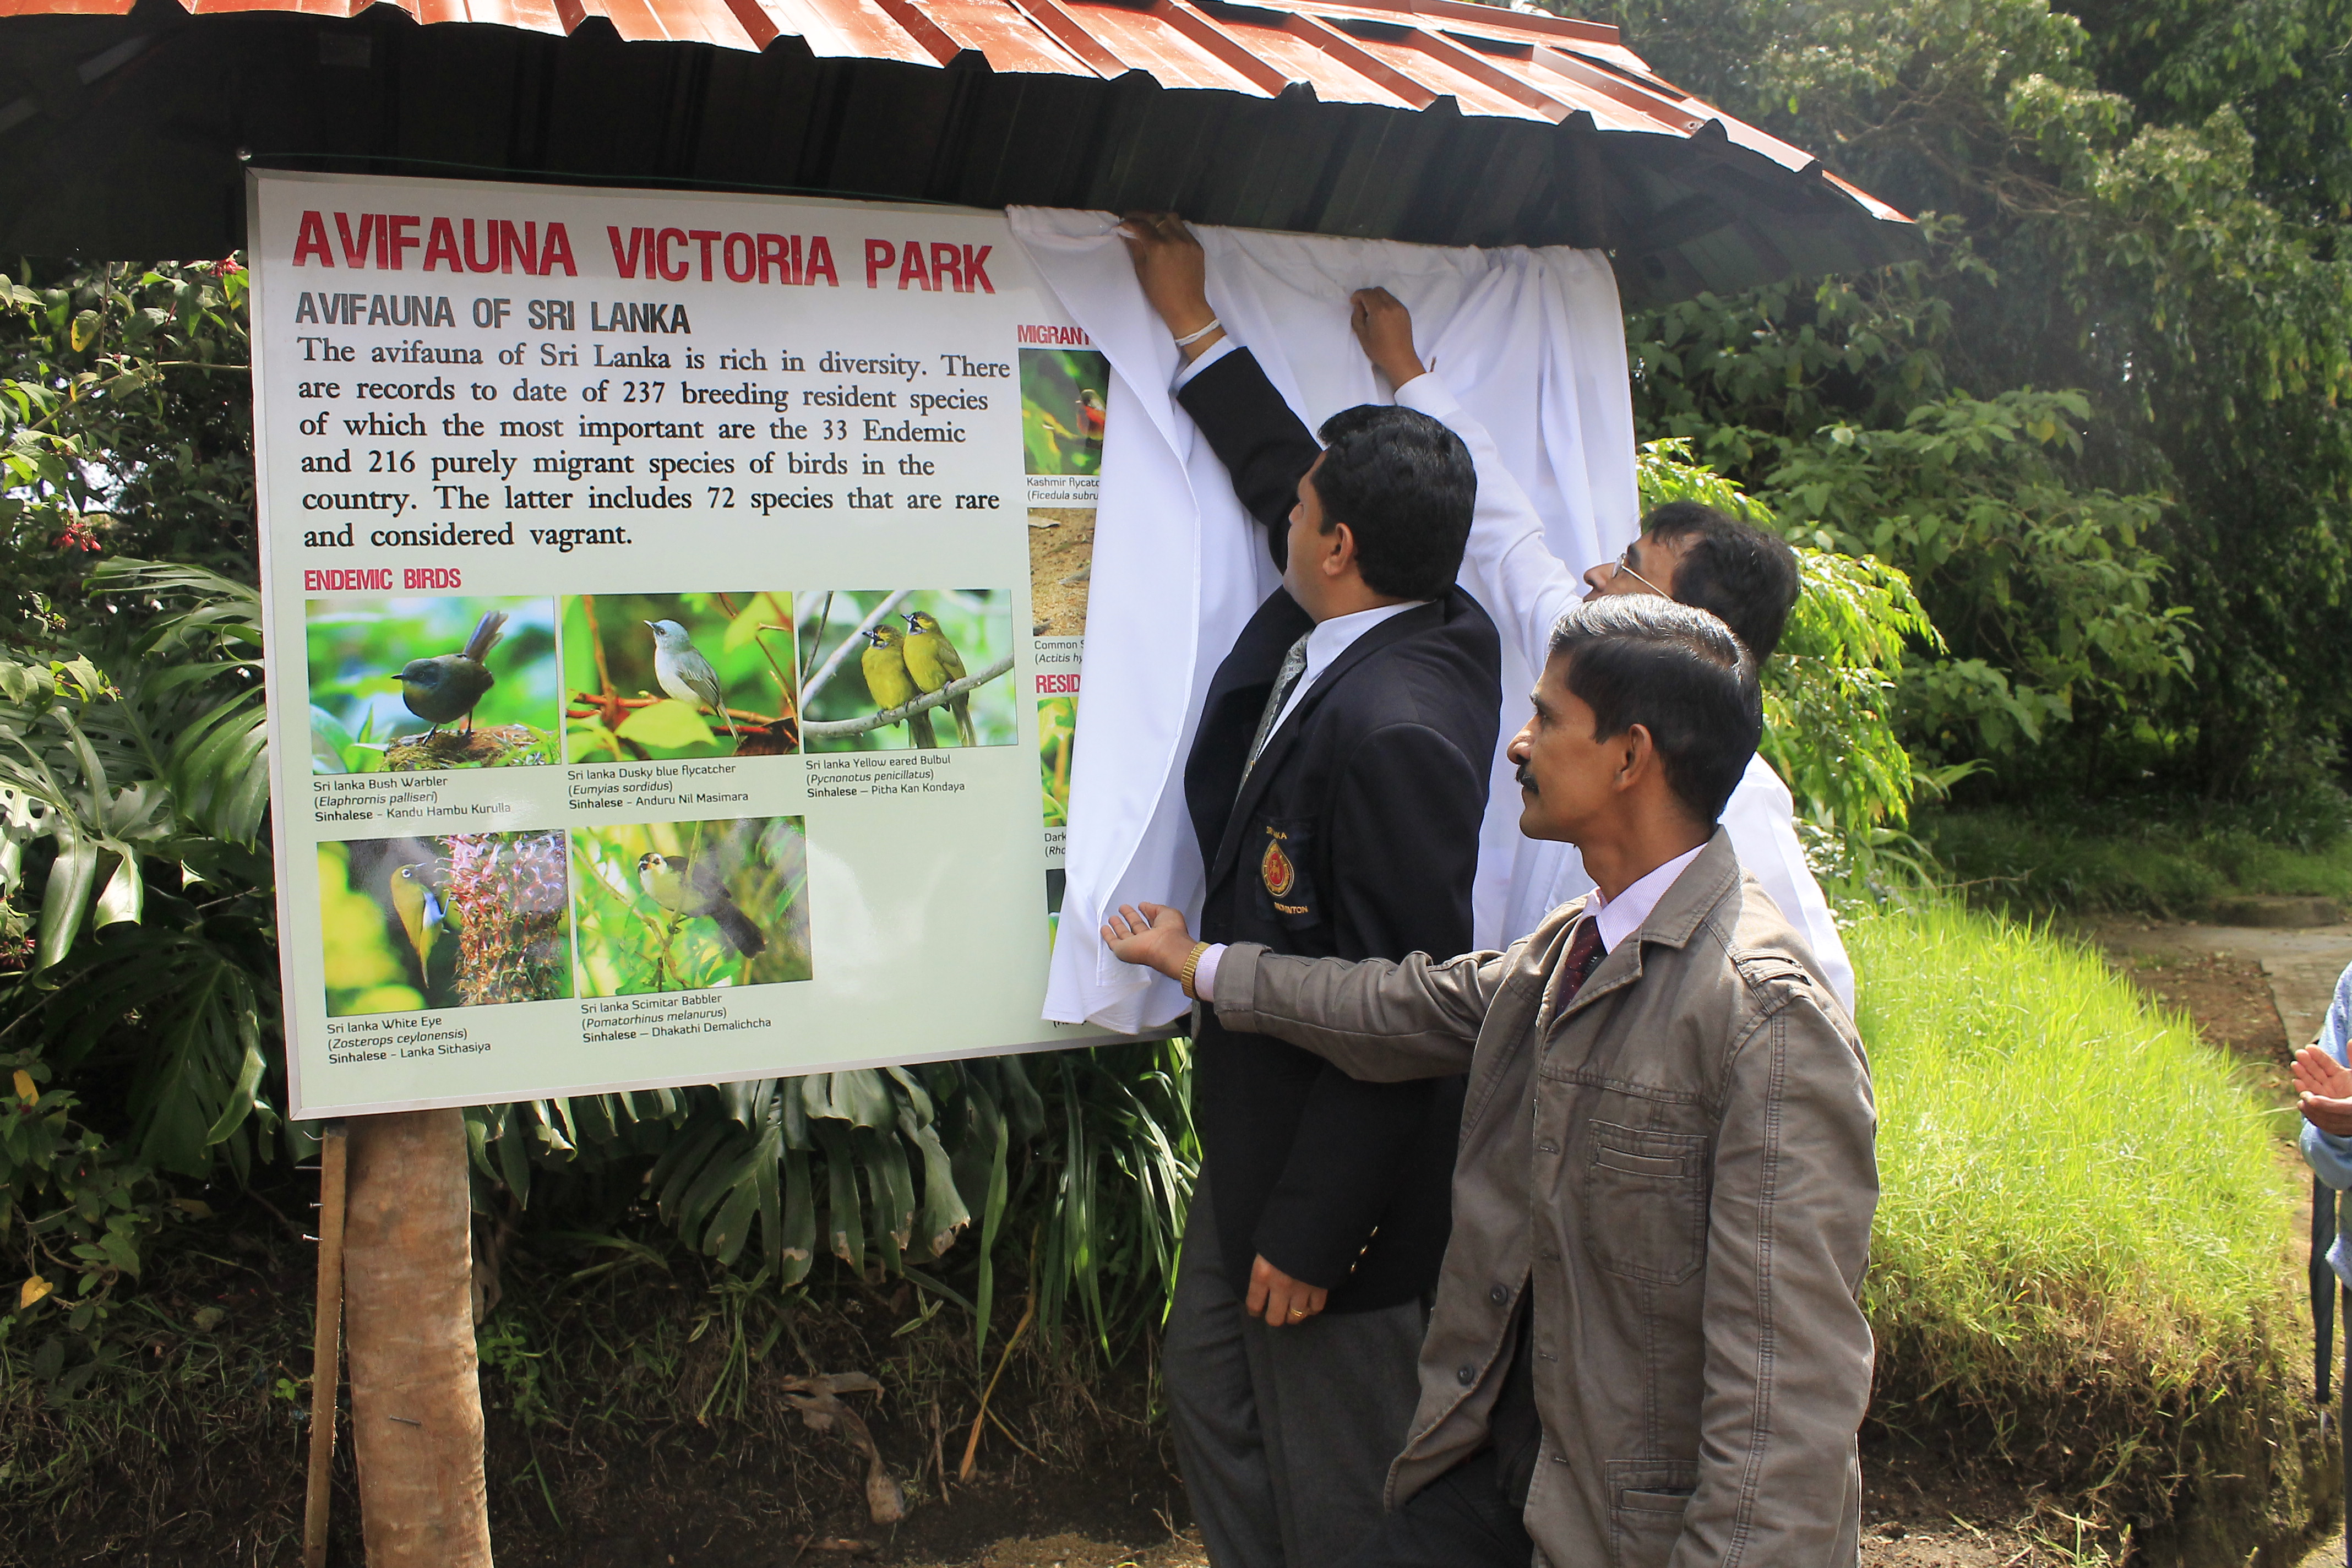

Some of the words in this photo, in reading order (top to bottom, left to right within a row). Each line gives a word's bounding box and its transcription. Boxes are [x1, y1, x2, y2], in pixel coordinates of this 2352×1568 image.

[293, 210, 578, 276] AVIFAUNA
[607, 226, 839, 286] VICTORIA
[865, 238, 995, 293] PARK
[296, 292, 456, 327] AVIFAUNA
[473, 298, 510, 328] OF
[529, 300, 574, 330] SRI
[591, 302, 691, 334] LANKA
[297, 337, 355, 362] The
[372, 340, 483, 364] avifauna
[499, 342, 526, 364] of
[541, 343, 579, 366] Sri
[594, 345, 671, 368] Lanka
[686, 347, 704, 369] is
[720, 349, 767, 370] rich
[782, 350, 805, 371] in
[819, 351, 926, 382] diversity.
[940, 355, 1010, 378] There
[299, 383, 340, 398] are
[357, 377, 455, 400] records
[471, 383, 497, 400] to
[513, 378, 567, 401] date
[582, 379, 609, 401] of
[623, 381, 665, 403] 237
[681, 381, 788, 412] breeding
[803, 385, 896, 407] resident
[911, 389, 988, 416] species
[300, 411, 329, 435] of
[343, 412, 427, 435] which
[443, 413, 484, 436] the
[500, 420, 563, 437] most
[579, 415, 704, 445] important
[719, 424, 755, 439] are
[770, 417, 807, 439] the
[824, 420, 847, 440] 33
[863, 420, 966, 442] Endemic
[302, 449, 351, 472] and
[369, 450, 415, 472] 216
[431, 449, 518, 481] purely
[533, 450, 634, 481] migrant
[650, 451, 734, 481] species
[750, 451, 775, 473] of
[788, 451, 847, 474] birds
[862, 453, 885, 475] in
[899, 454, 934, 475] the
[1027, 477, 1066, 486] Kashmir
[303, 492, 416, 518] country.
[433, 486, 489, 509] The
[505, 486, 573, 509] latter
[589, 486, 692, 508] includes
[707, 487, 734, 508] 72
[751, 487, 833, 516] species
[847, 487, 894, 509] that
[907, 494, 941, 509] are
[956, 495, 999, 509] rare
[1028, 491, 1070, 502] (Ficedula
[304, 522, 355, 547] and
[371, 522, 514, 546] considered
[530, 527, 631, 553] vagrant.
[304, 569, 393, 590] ENDEMIC
[404, 568, 461, 589] BIRDS
[1035, 641, 1077, 649] Common
[1035, 654, 1070, 665] (Actitis
[1036, 674, 1080, 693] RESID
[806, 760, 820, 770] Sri
[824, 759, 850, 769] lanka
[853, 758, 886, 767] Yellow
[890, 756, 917, 766] eared
[921, 754, 950, 764] Bulbul
[568, 771, 583, 780] Sri
[587, 769, 615, 779] lanka
[619, 767, 652, 779] Dusky
[656, 766, 678, 776] blue
[682, 764, 736, 777] flycatcher
[807, 774, 871, 786] (Pycnonotus
[874, 769, 933, 783] penicillatus)
[314, 782, 330, 791] Sri
[335, 780, 364, 790] lanka
[369, 778, 397, 788] Bush
[401, 776, 448, 787] Warbler
[569, 784, 619, 797] (Eumyias
[623, 781, 672, 792] sordidus)
[808, 787, 857, 797] Sinhalese
[872, 785, 897, 794] Pitha
[901, 784, 919, 793] Kan
[923, 782, 965, 793] Kondaya
[315, 794, 385, 809] (Elaphrornis
[390, 791, 437, 806] palliseri)
[569, 798, 623, 809] Sinhalese
[636, 796, 675, 805] Anduru
[679, 794, 693, 803] Nil
[697, 793, 748, 802] Masimara
[315, 810, 372, 821] Sinhalese
[387, 807, 423, 818] Kandu
[427, 805, 467, 816] Hambu
[472, 803, 510, 814] Kurulla
[581, 1004, 596, 1014] Sri
[601, 1001, 628, 1012] lanka
[632, 999, 678, 1009] Scimitar
[682, 994, 722, 1005] Babbler
[328, 1023, 344, 1034] Sri
[348, 1021, 378, 1032] lanka
[382, 1019, 417, 1029] White
[422, 1017, 442, 1028] Eye
[582, 1014, 663, 1031] (Pomatorhinus
[667, 1007, 726, 1021] melanurus)
[329, 1037, 393, 1051] (Zosterops
[398, 1028, 467, 1045] ceylonensis)
[583, 1031, 636, 1042] Sinhalese
[652, 1024, 700, 1036] Dhakathi
[704, 1018, 771, 1032] Demalichcha
[329, 1051, 386, 1064] Sinhalese
[401, 1047, 434, 1058] Lanka
[438, 1042, 491, 1054] Sithasiya
